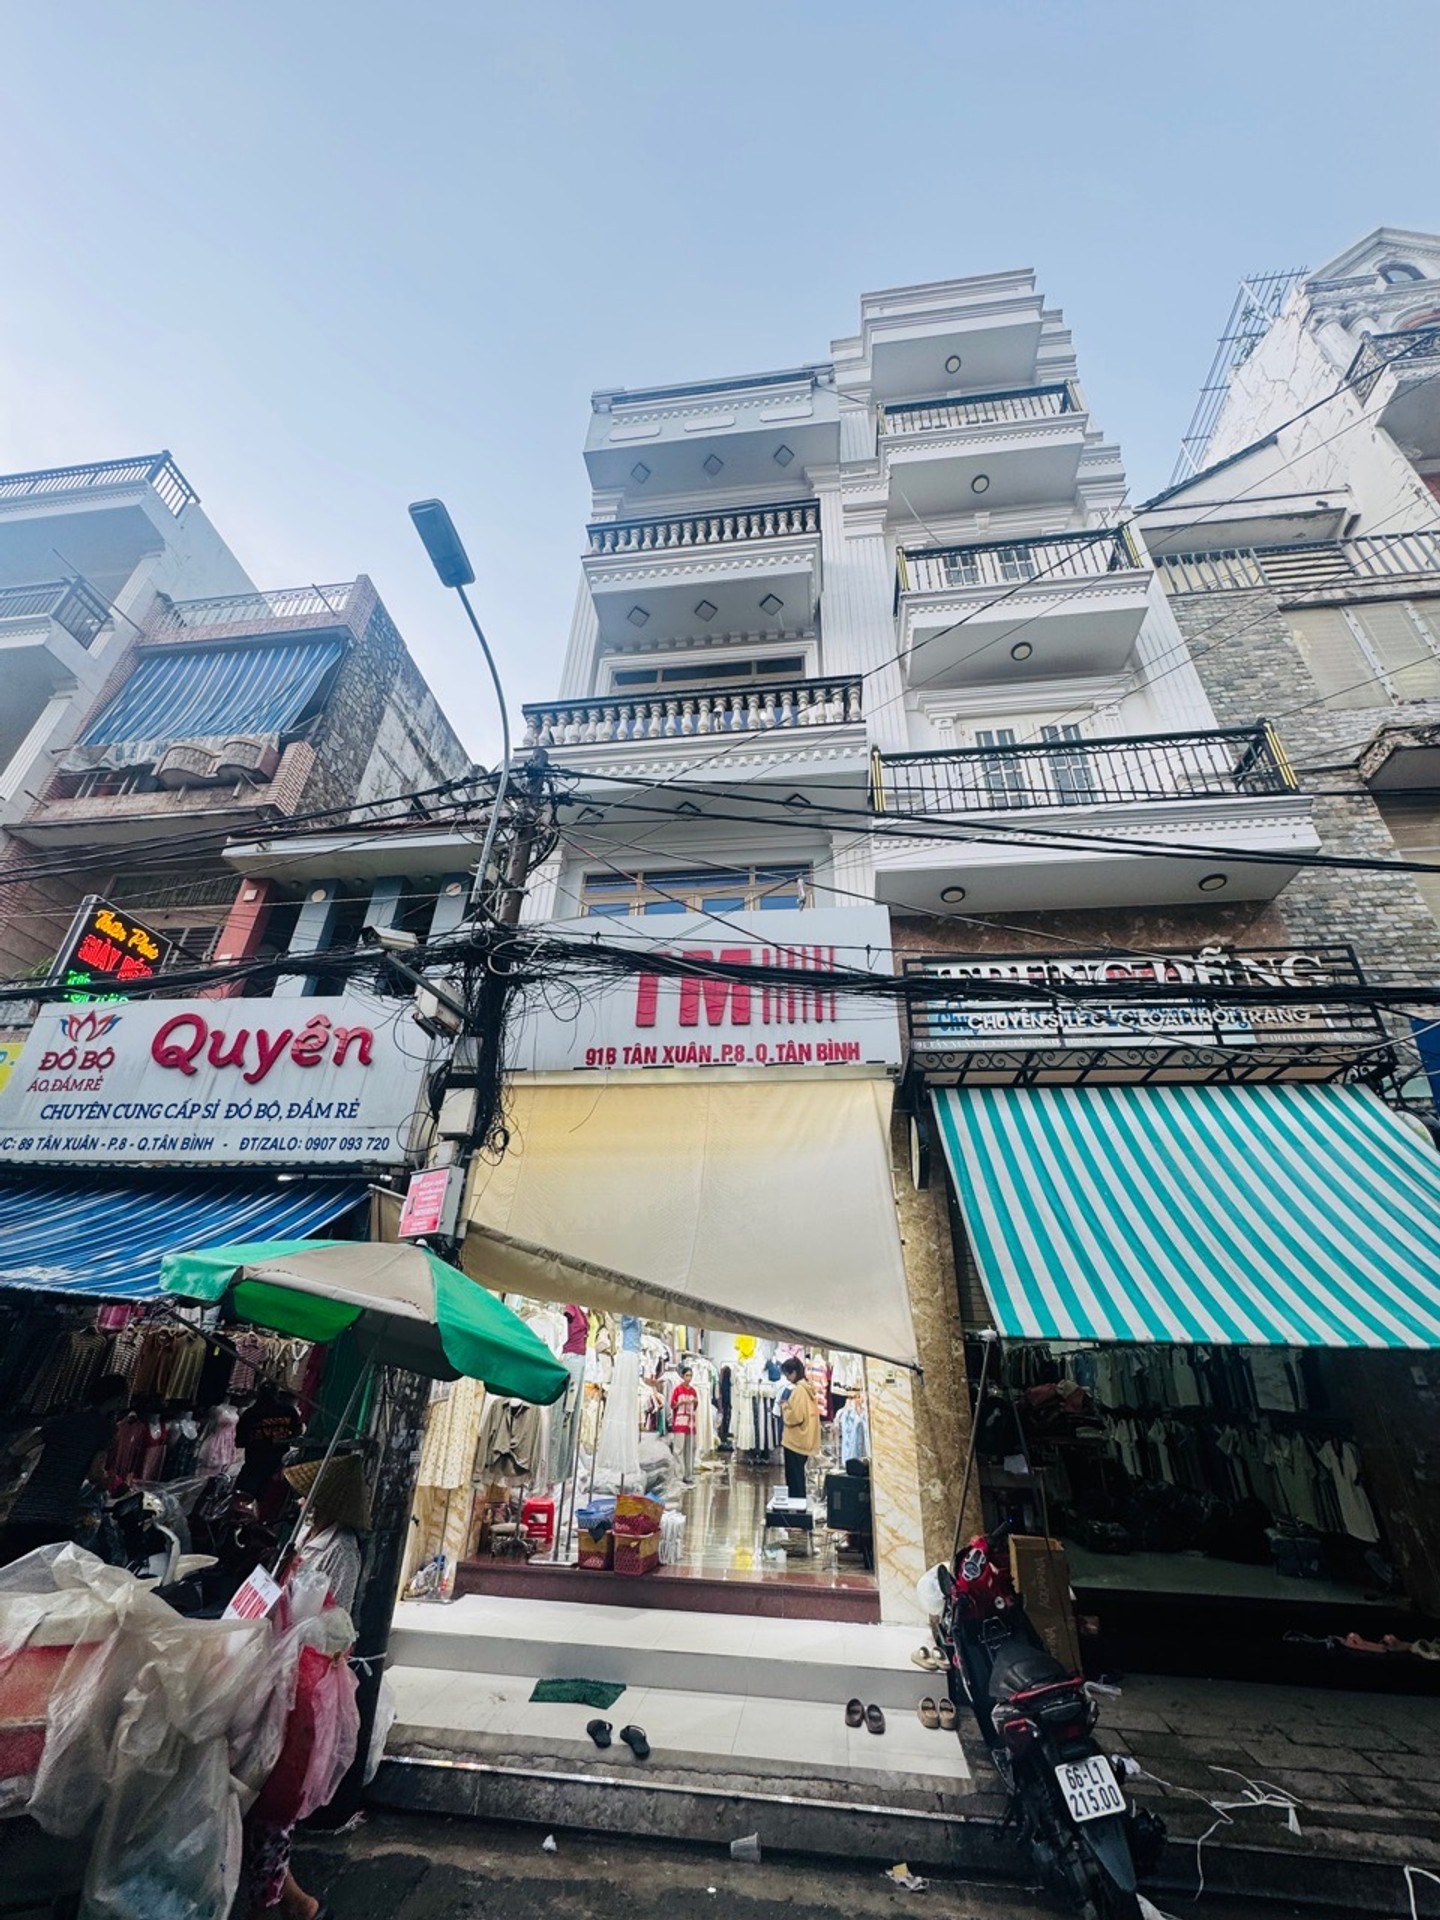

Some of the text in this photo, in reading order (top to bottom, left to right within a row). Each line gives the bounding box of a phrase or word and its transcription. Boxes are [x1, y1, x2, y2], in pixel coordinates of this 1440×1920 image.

[968, 1007, 1045, 1029] CHUYÊN
[38, 1045, 78, 1071] ĐỒ
[78, 1046, 115, 1073] BỘ
[151, 1013, 374, 1085] Quyên
[585, 1046, 617, 1066] 91B
[623, 1042, 657, 1064] TÂN
[816, 1038, 860, 1062] BÌNH
[40, 1101, 113, 1120] CHUYÊN
[112, 1103, 163, 1120] CUNG
[164, 1098, 201, 1119] CẤP
[254, 1100, 283, 1122] BỘ,
[17, 1137, 34, 1151] 89
[36, 1134, 63, 1151] TÂN
[62, 1134, 100, 1151] XUÂN
[107, 1137, 128, 1151] P.8
[180, 1132, 215, 1151] BÌNH
[239, 1136, 303, 1151] ĐT/ZALO:
[304, 1136, 337, 1151] 0907
[338, 1136, 363, 1151] 093
[366, 1136, 390, 1151] 720
[1069, 1784, 1121, 1817] 215.00
